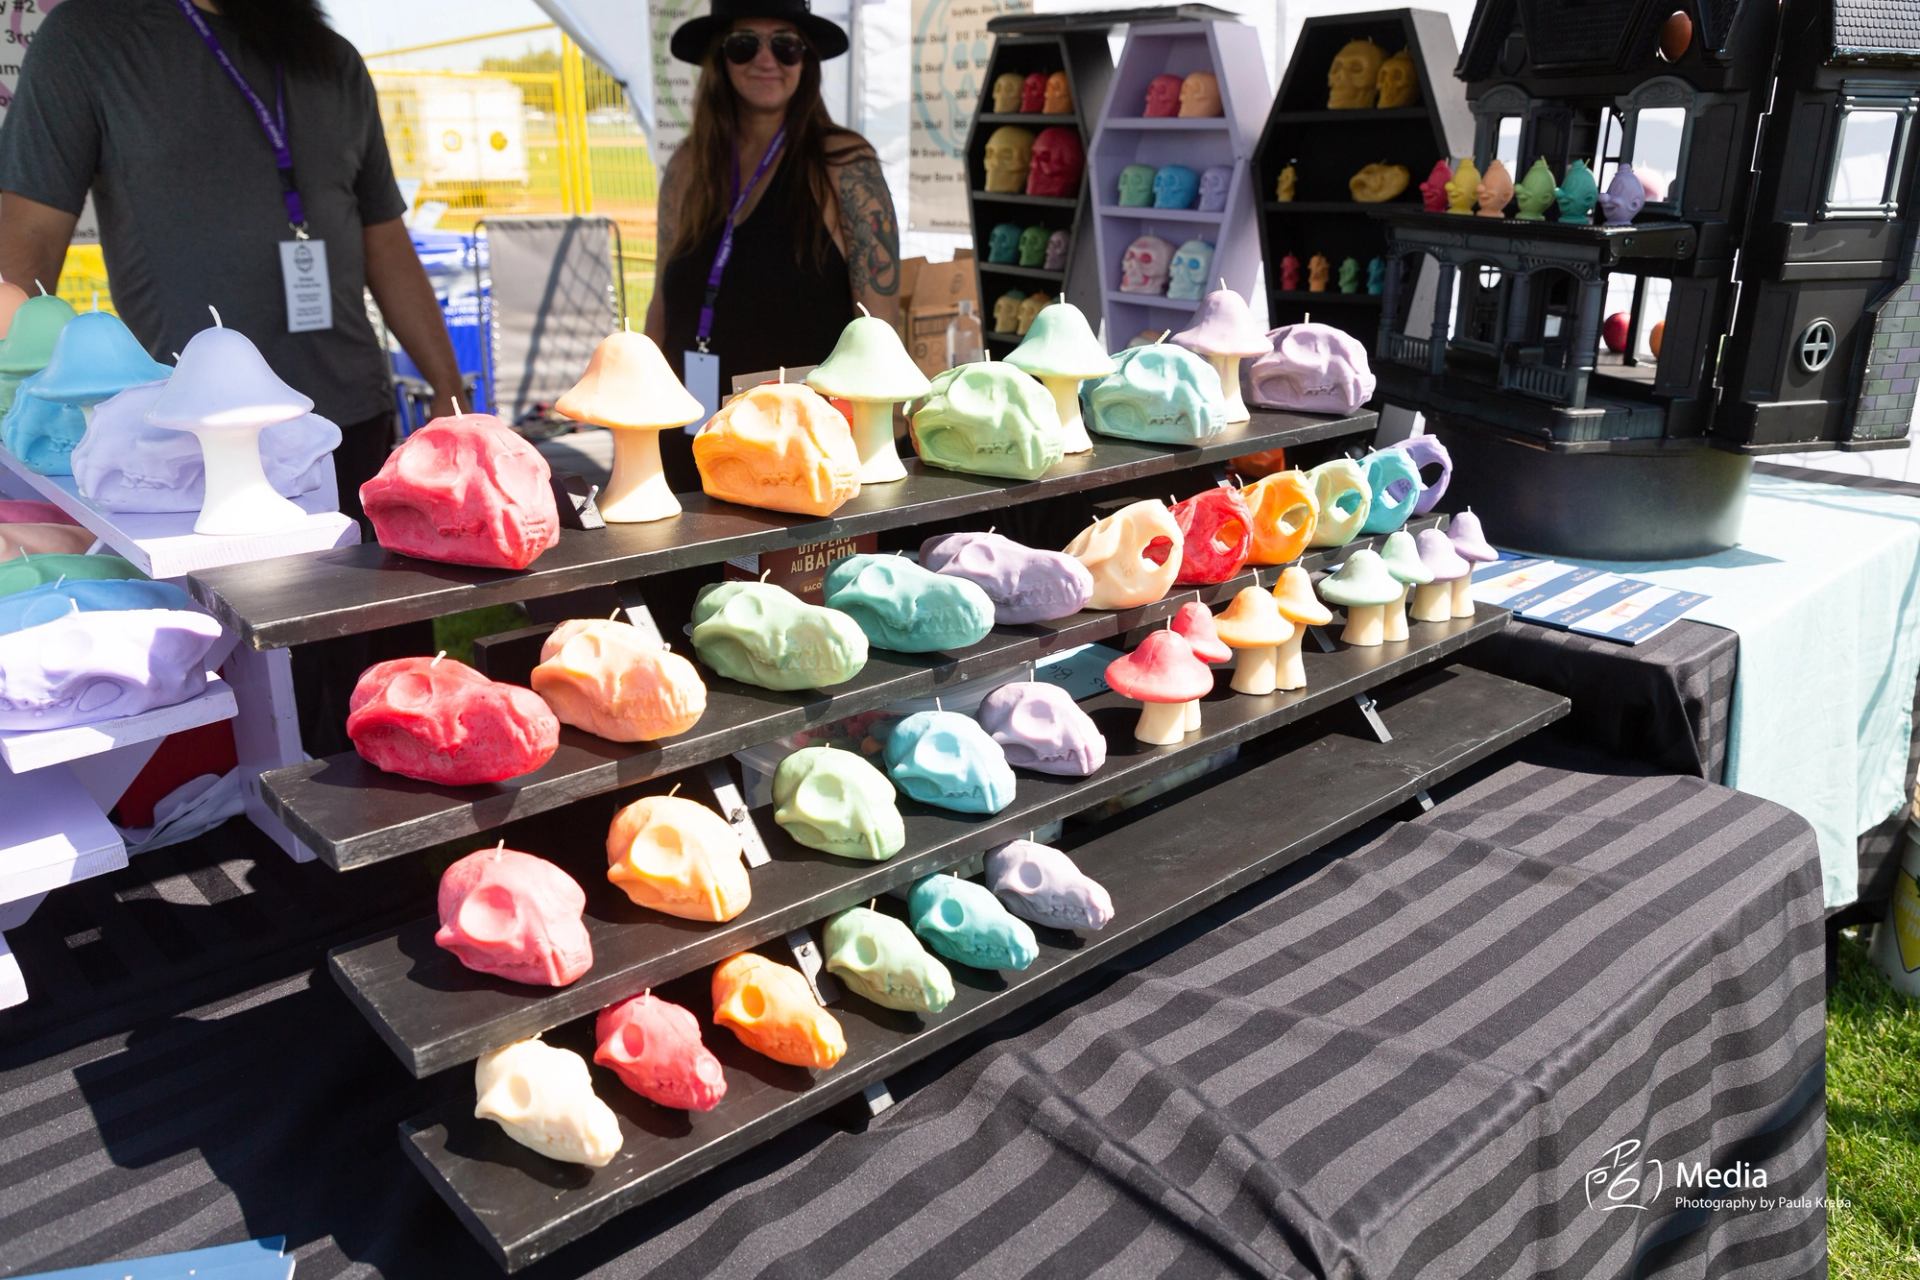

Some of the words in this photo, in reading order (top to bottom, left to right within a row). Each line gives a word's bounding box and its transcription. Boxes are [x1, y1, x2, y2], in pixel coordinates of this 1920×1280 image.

[791, 560, 803, 573] AU
[805, 542, 857, 572] BACON
[804, 583, 823, 593] BACO
